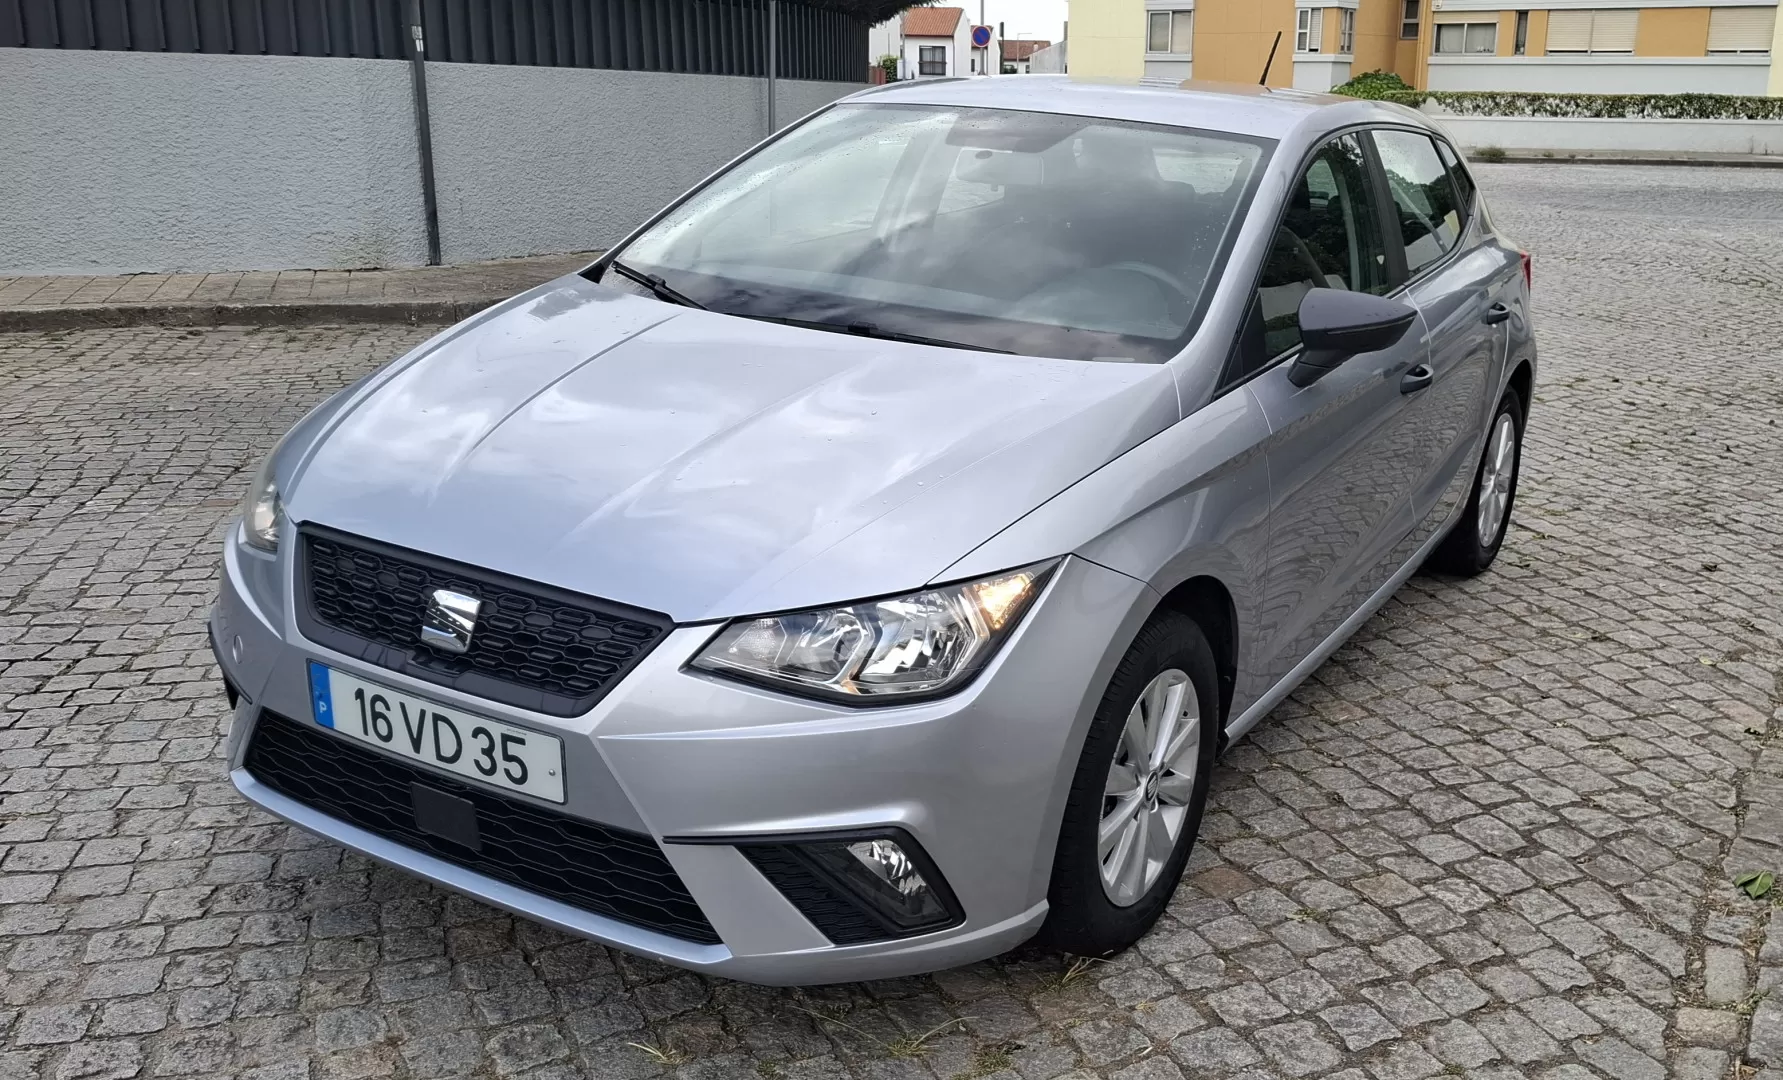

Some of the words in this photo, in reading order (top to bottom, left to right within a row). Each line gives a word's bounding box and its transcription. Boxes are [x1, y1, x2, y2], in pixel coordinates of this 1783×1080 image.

[319, 702, 327, 714] P
[355, 688, 393, 743] 16
[400, 702, 462, 764] VD
[472, 727, 528, 785] 35
